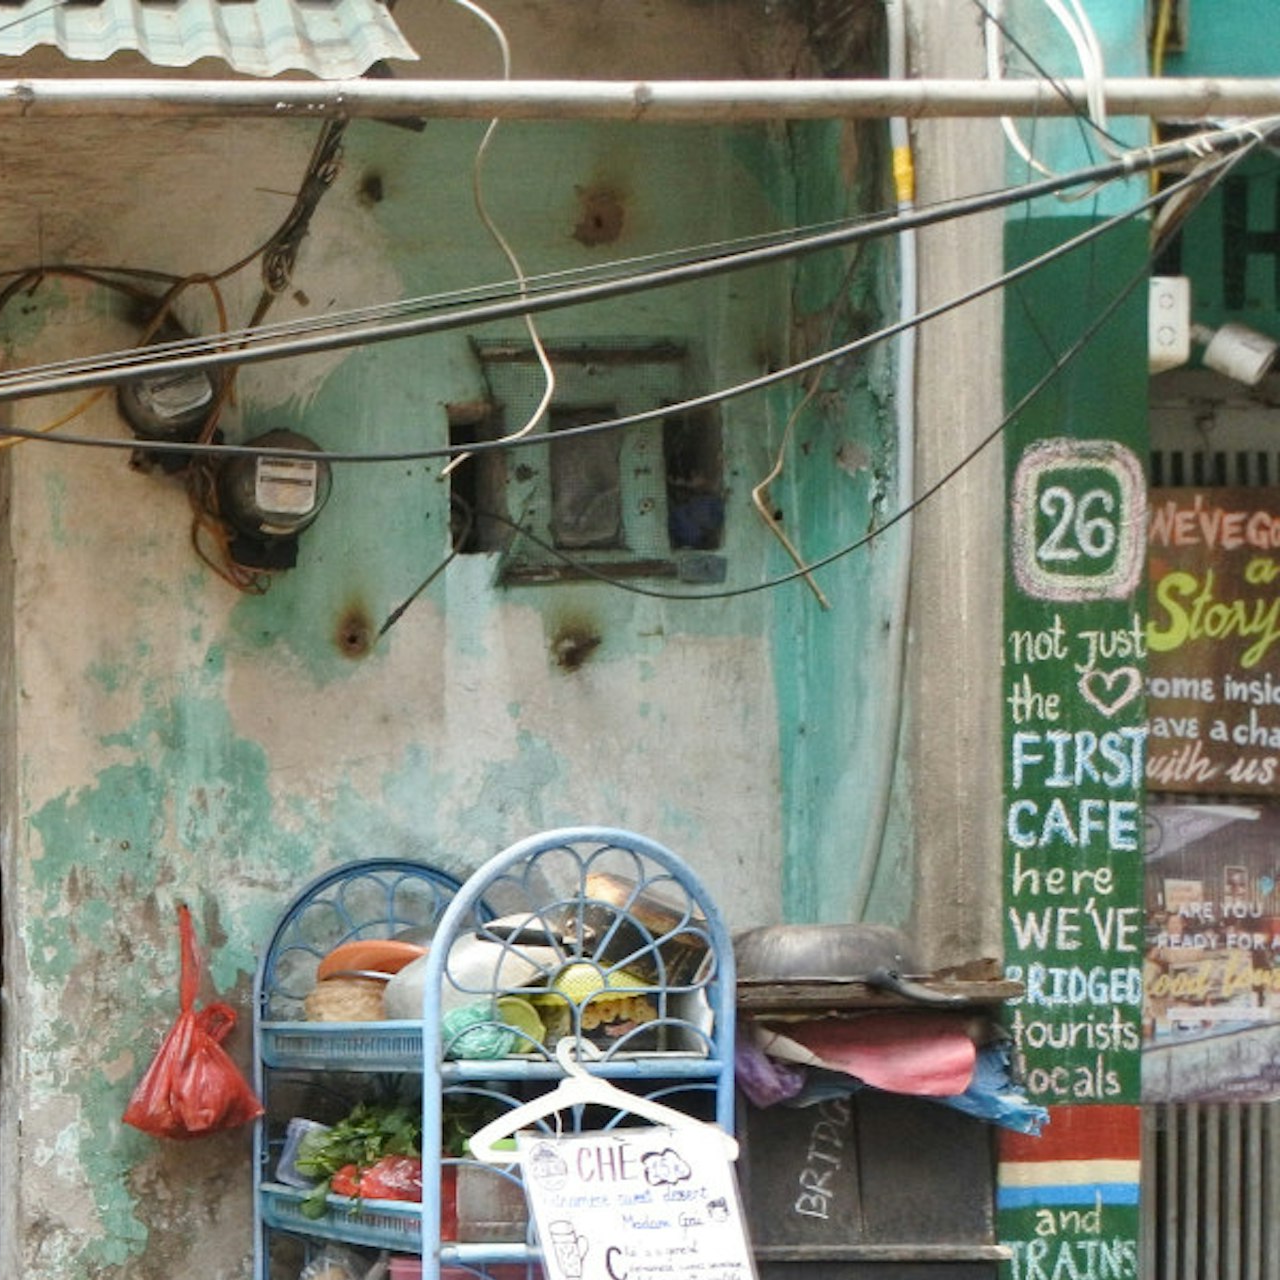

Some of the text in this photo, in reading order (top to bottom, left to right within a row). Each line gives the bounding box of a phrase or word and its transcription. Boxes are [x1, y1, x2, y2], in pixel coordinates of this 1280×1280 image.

[1036, 486, 1115, 562] 26
[1147, 569, 1280, 668] Story
[1009, 613, 1147, 673] not just
[1007, 673, 1061, 725] the
[1145, 676, 1215, 703] ome
[1152, 716, 1201, 739] ave
[1012, 726, 1148, 790] FIRST
[1225, 756, 1279, 786] us
[1007, 798, 1139, 852] CAFE
[1012, 853, 1114, 896] here
[1008, 897, 1140, 952] WE'VE
[1221, 901, 1264, 919] YOU
[1004, 962, 1142, 1008] BRIDGED
[1011, 1006, 1140, 1052] tourists
[1017, 1052, 1122, 1099] locals
[1035, 1188, 1102, 1237] and
